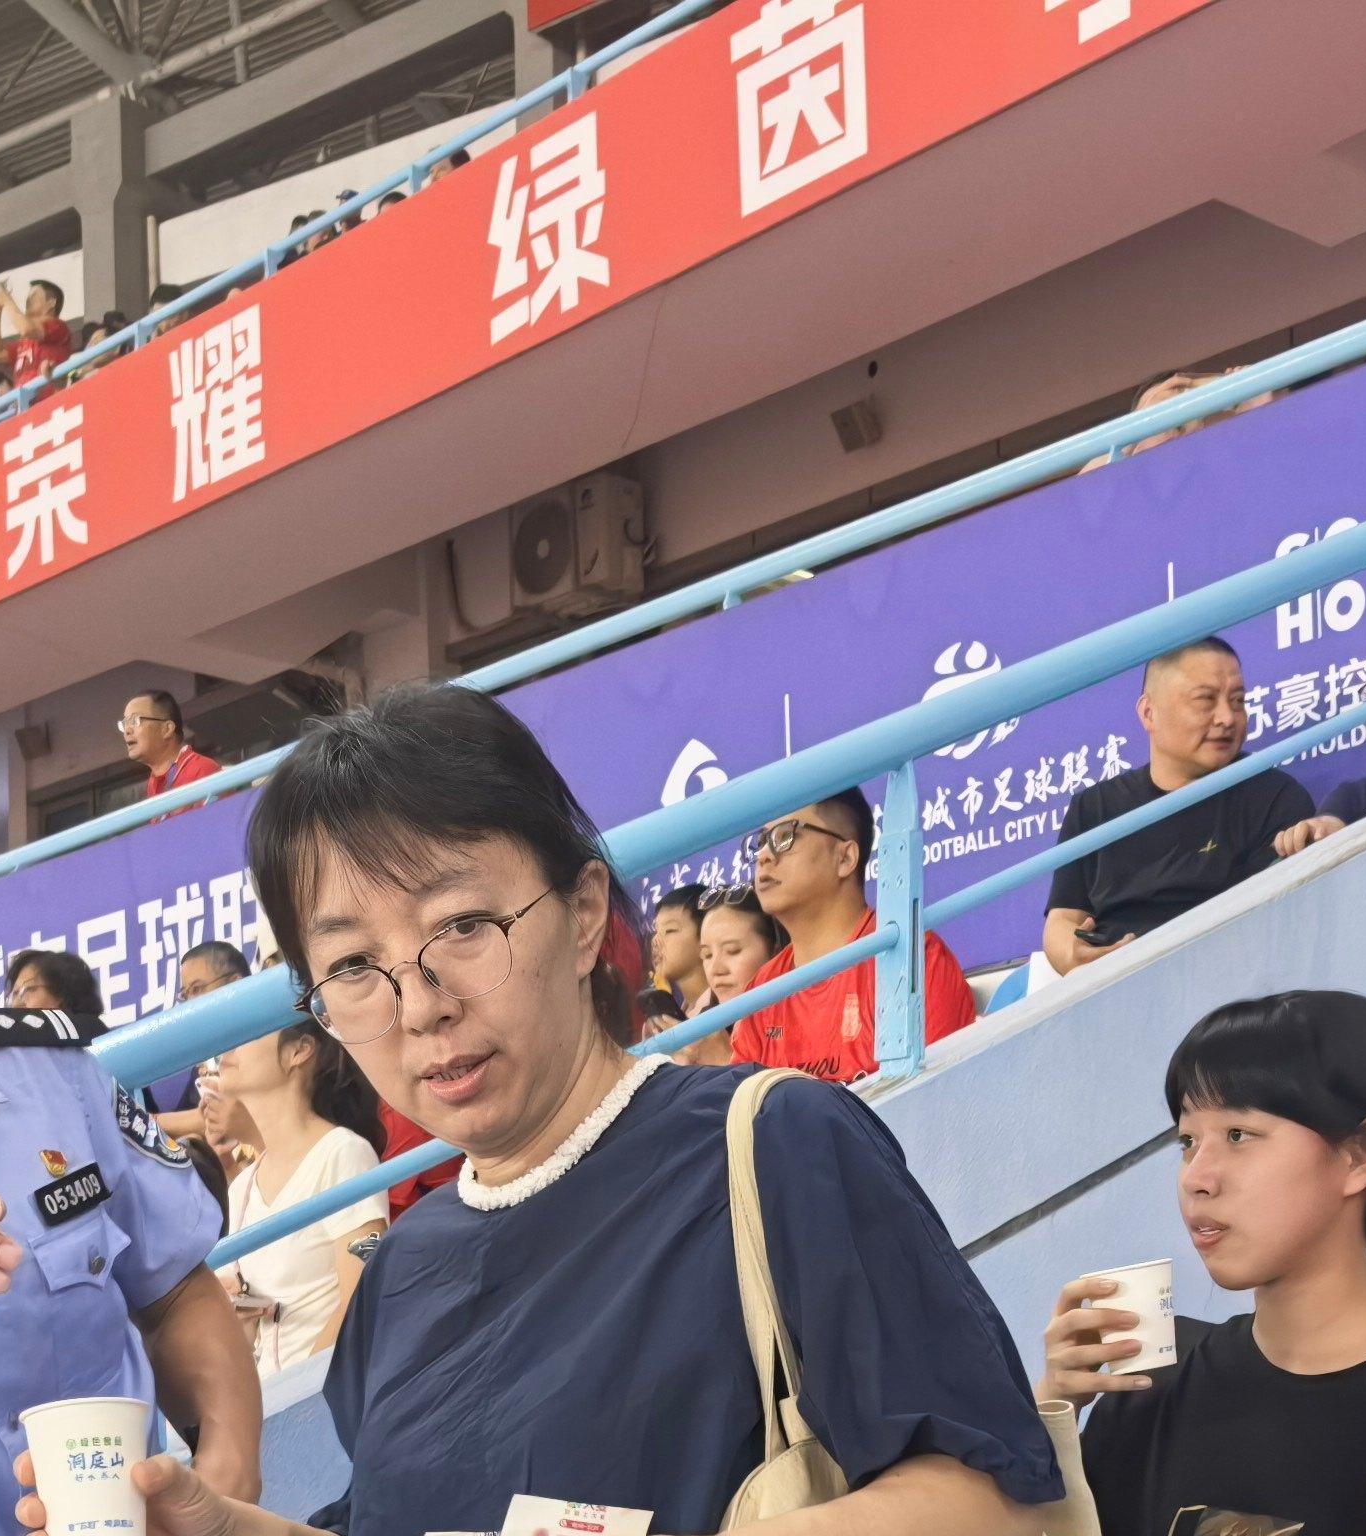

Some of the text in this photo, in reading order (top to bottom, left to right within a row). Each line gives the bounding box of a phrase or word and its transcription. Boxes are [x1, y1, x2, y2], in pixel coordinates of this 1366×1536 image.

[873, 733, 1132, 849] 城市足球联赛
[1004, 810, 1049, 843] CITY
[67, 1450, 125, 1471] 洞庭山
